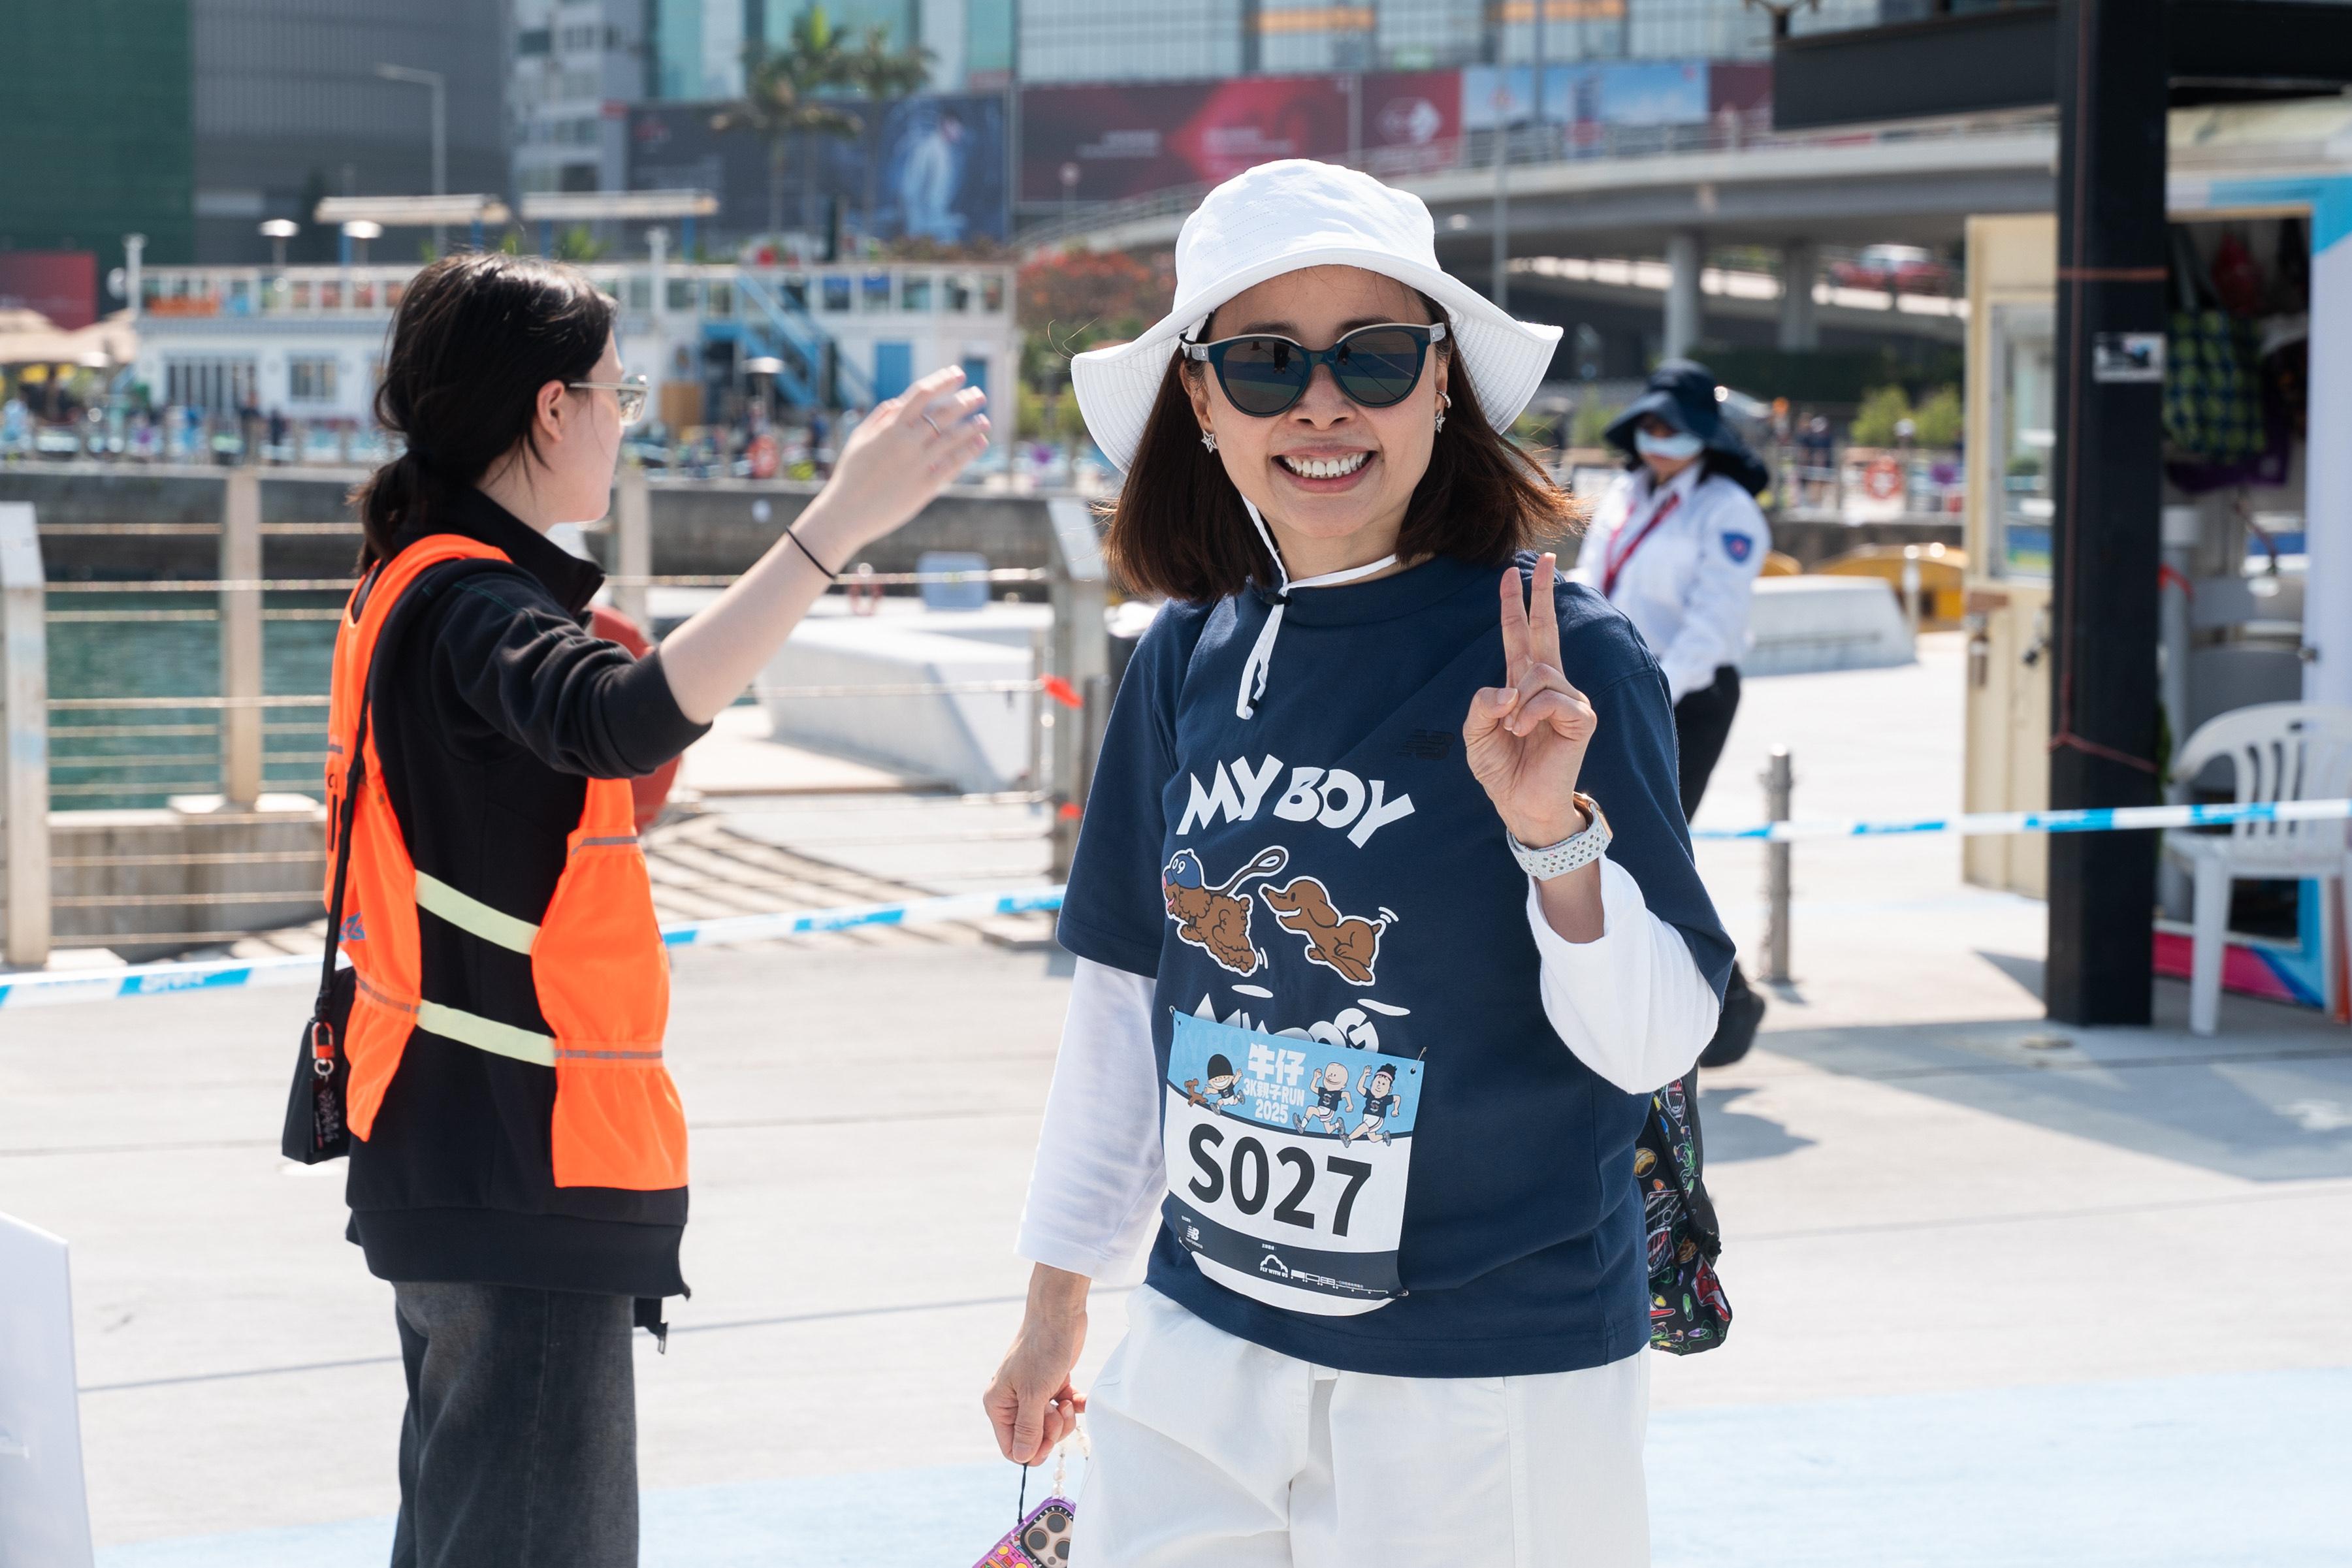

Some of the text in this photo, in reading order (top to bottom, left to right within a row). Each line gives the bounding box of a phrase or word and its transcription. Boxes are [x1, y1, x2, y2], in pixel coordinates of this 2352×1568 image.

[1176, 754, 1415, 849] MY BOY
[1172, 858, 1185, 874] 09
[1248, 1042, 1306, 1086] 牛仔
[1255, 1098, 1289, 1124] 2025
[1187, 1123, 1372, 1237] S027
